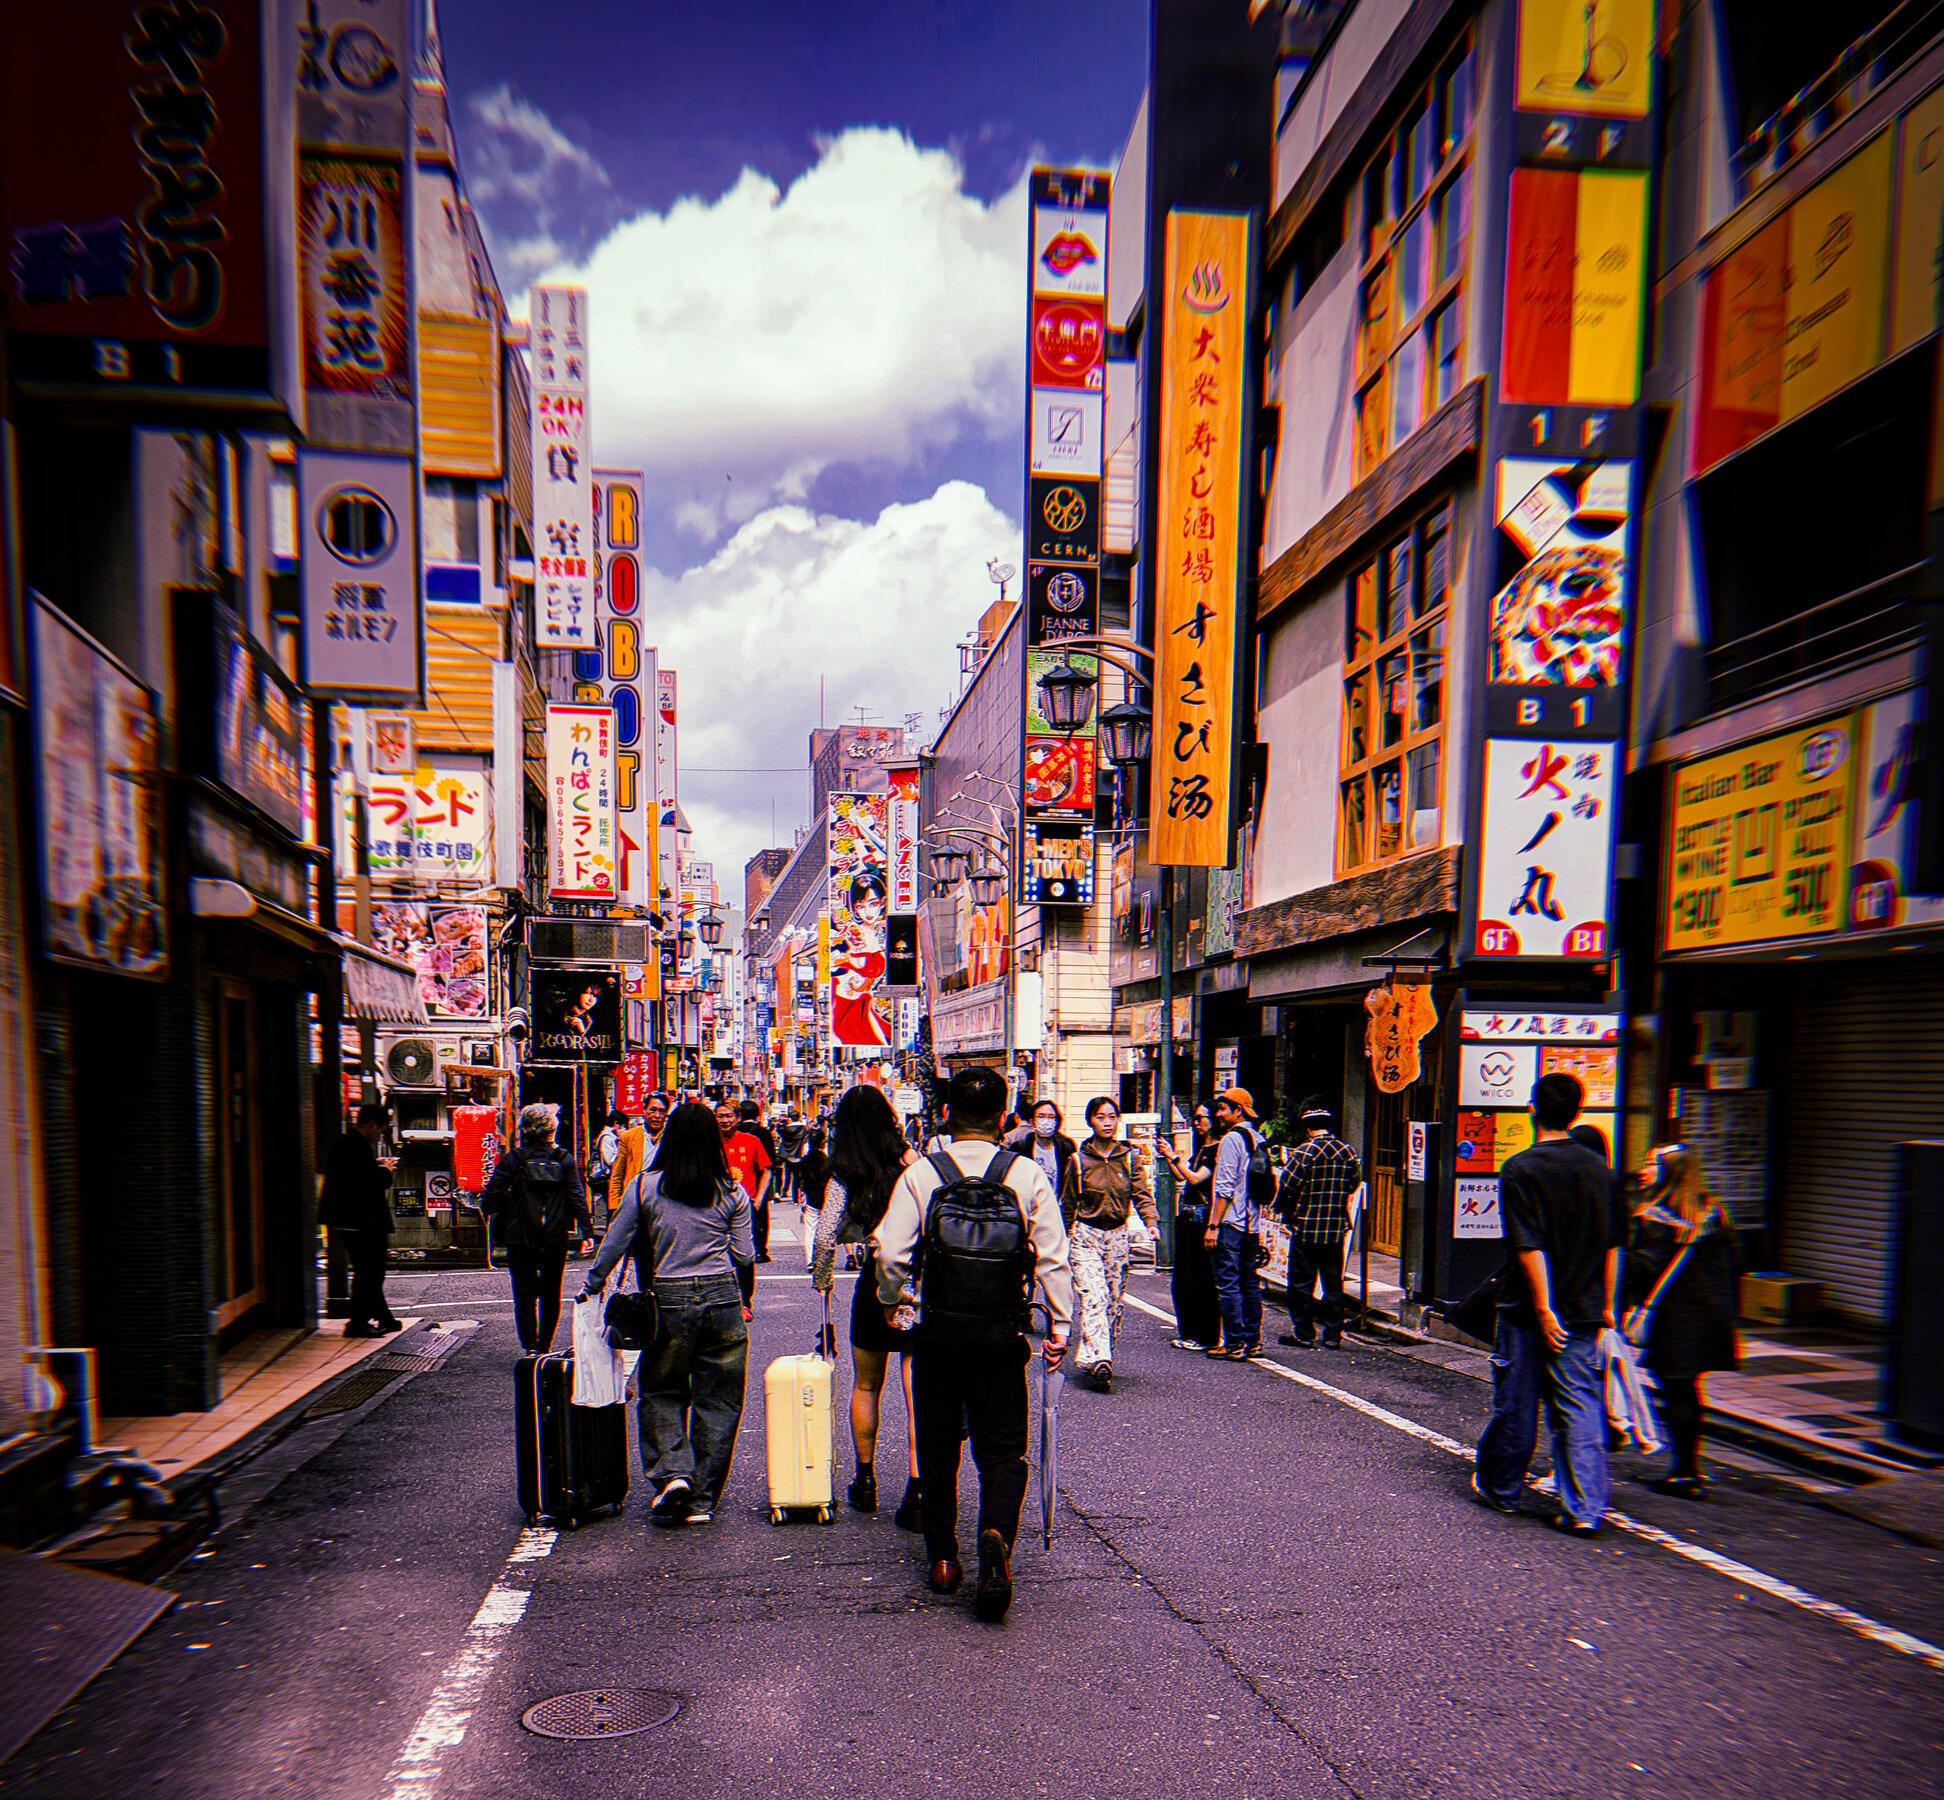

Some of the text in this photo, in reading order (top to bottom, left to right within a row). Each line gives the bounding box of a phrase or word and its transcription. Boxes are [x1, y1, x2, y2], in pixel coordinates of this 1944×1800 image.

[1181, 327, 1220, 584] 大衆寿し酒場
[1041, 542, 1087, 556] CERN
[1041, 615, 1090, 631] JEANNE
[607, 483, 641, 812] ROBOT
[1167, 601, 1218, 821] すさび湯
[1517, 695, 1593, 727] B1
[598, 718, 609, 758] 歌舞伎町
[368, 786, 479, 827] ランド
[570, 722, 593, 883] わんぱくランド
[599, 769, 609, 808] 24時間
[1510, 744, 1570, 921] 火ノ丸
[596, 876, 609, 886] 2F
[1032, 858, 1086, 880] TOKYO
[1482, 929, 1511, 951] 6F
[1480, 1088, 1514, 1098] WICO
